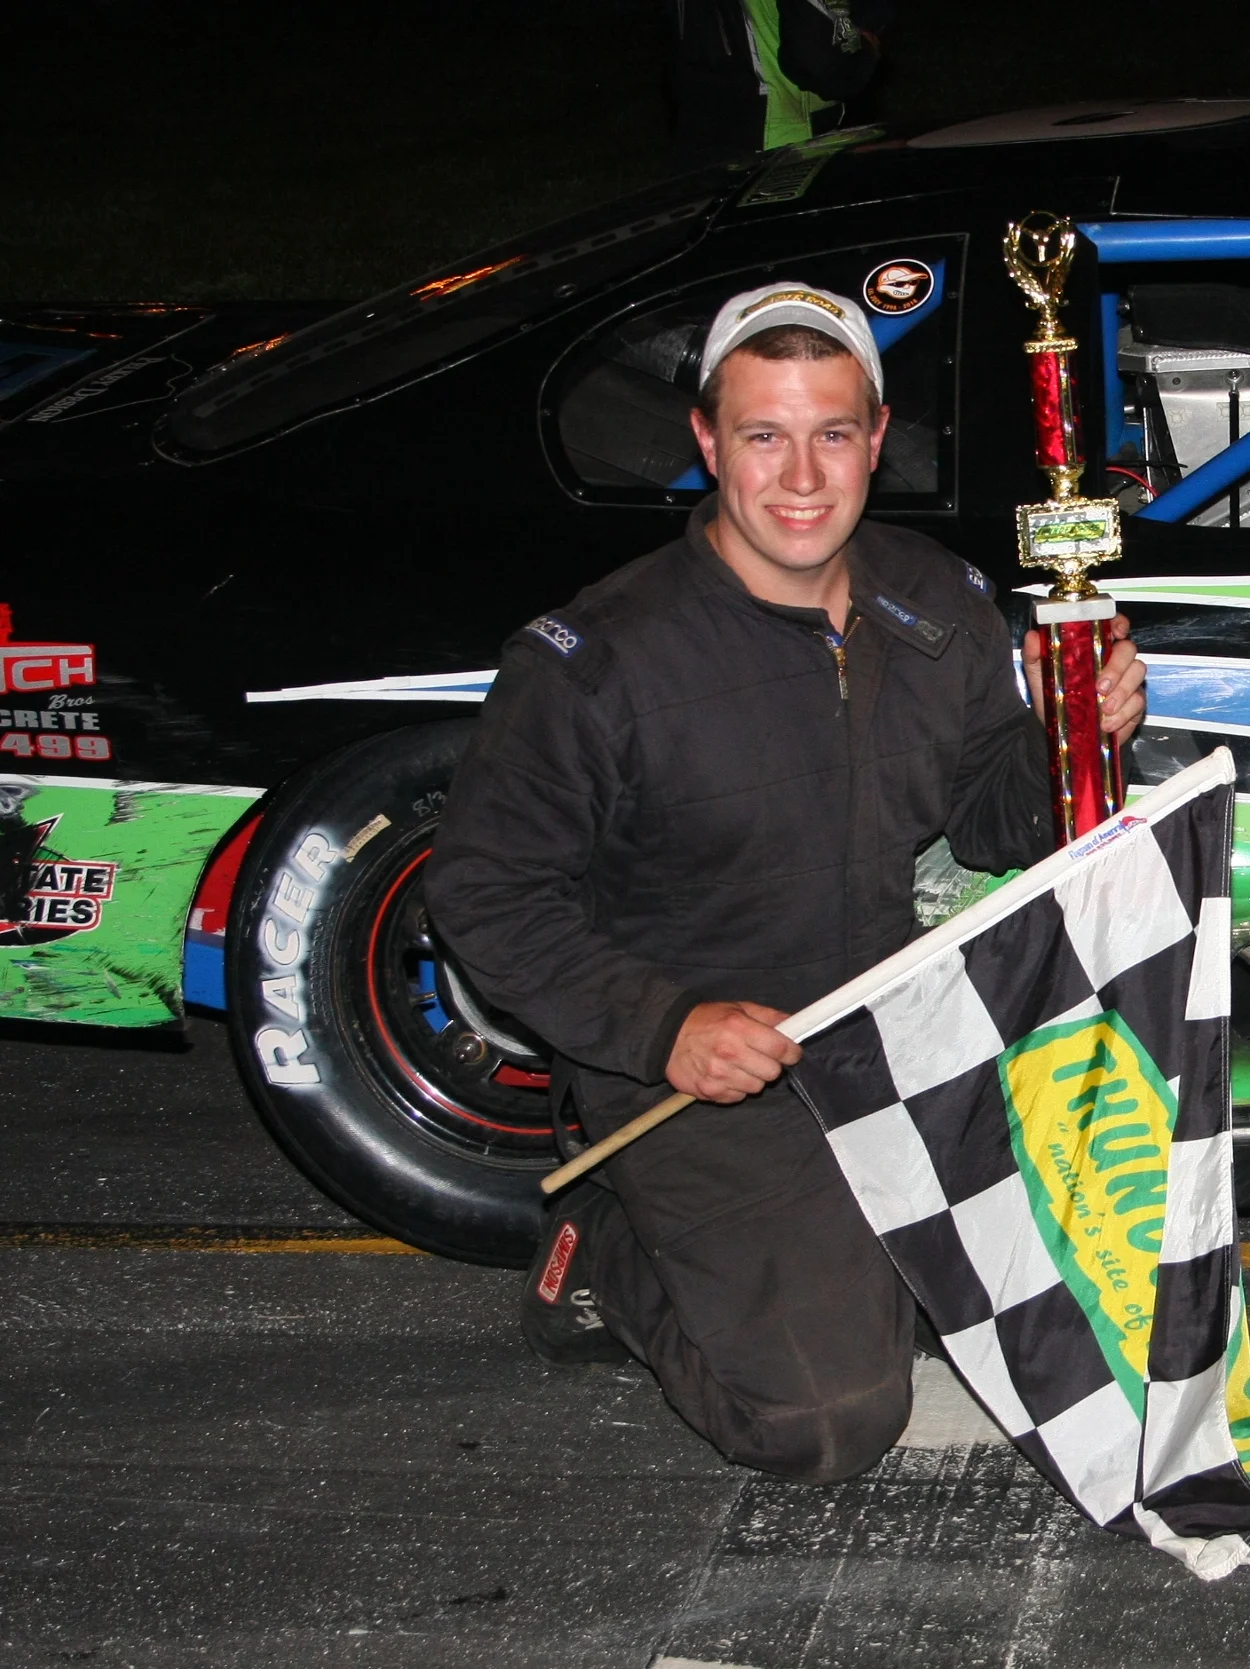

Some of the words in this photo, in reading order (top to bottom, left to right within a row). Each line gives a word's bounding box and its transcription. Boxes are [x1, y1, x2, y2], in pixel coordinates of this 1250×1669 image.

[48, 694, 95, 709] Bros
[2, 733, 110, 760] 499
[255, 832, 337, 1087] RACER
[543, 1228, 575, 1295] SIMPSON
[1096, 1249, 1129, 1293] site
[1123, 1303, 1154, 1331] of
